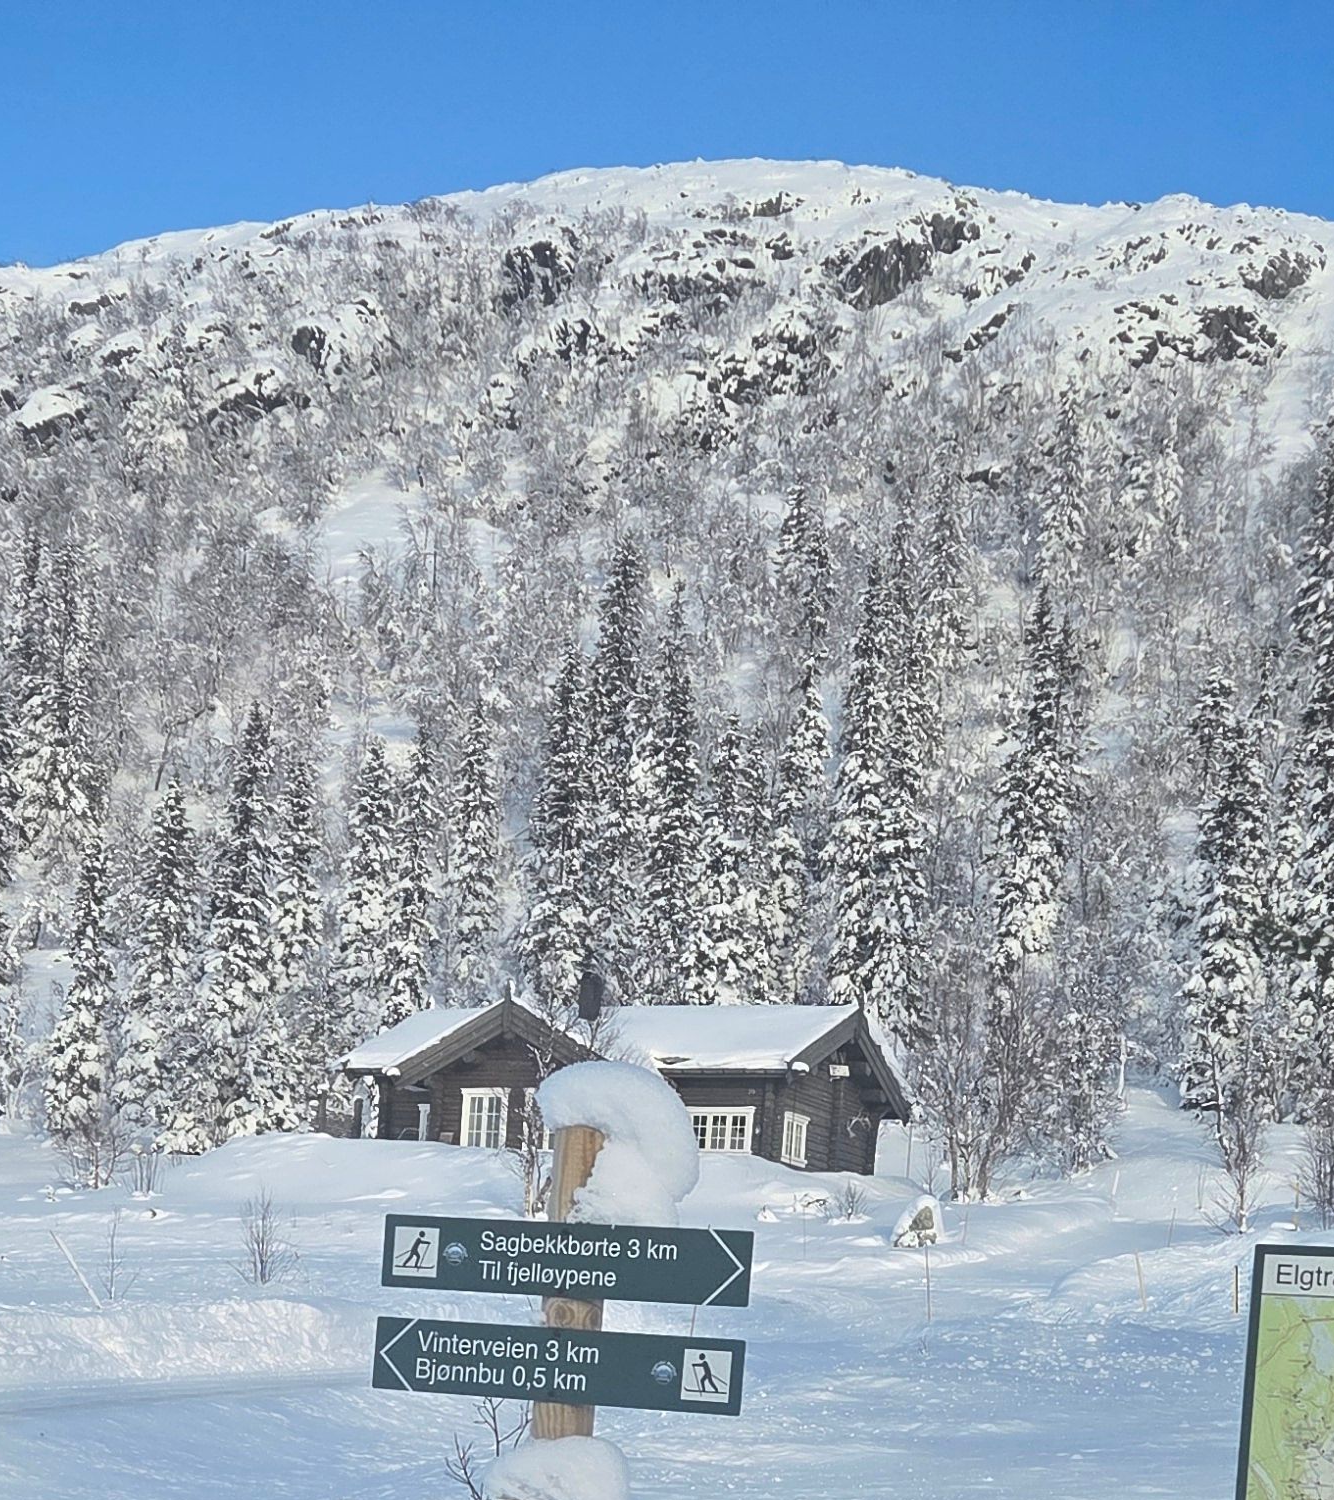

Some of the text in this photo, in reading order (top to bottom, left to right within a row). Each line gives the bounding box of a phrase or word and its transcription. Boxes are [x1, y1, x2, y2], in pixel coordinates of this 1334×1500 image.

[480, 1230, 621, 1258] Sagbekkbørte
[627, 1238, 640, 1258] 3
[647, 1238, 677, 1260] km
[478, 1260, 617, 1289] Til fjelløypene
[418, 1330, 599, 1364] Vinterveien 3 km
[415, 1357, 586, 1392] Bjønnbu 0,5 km
